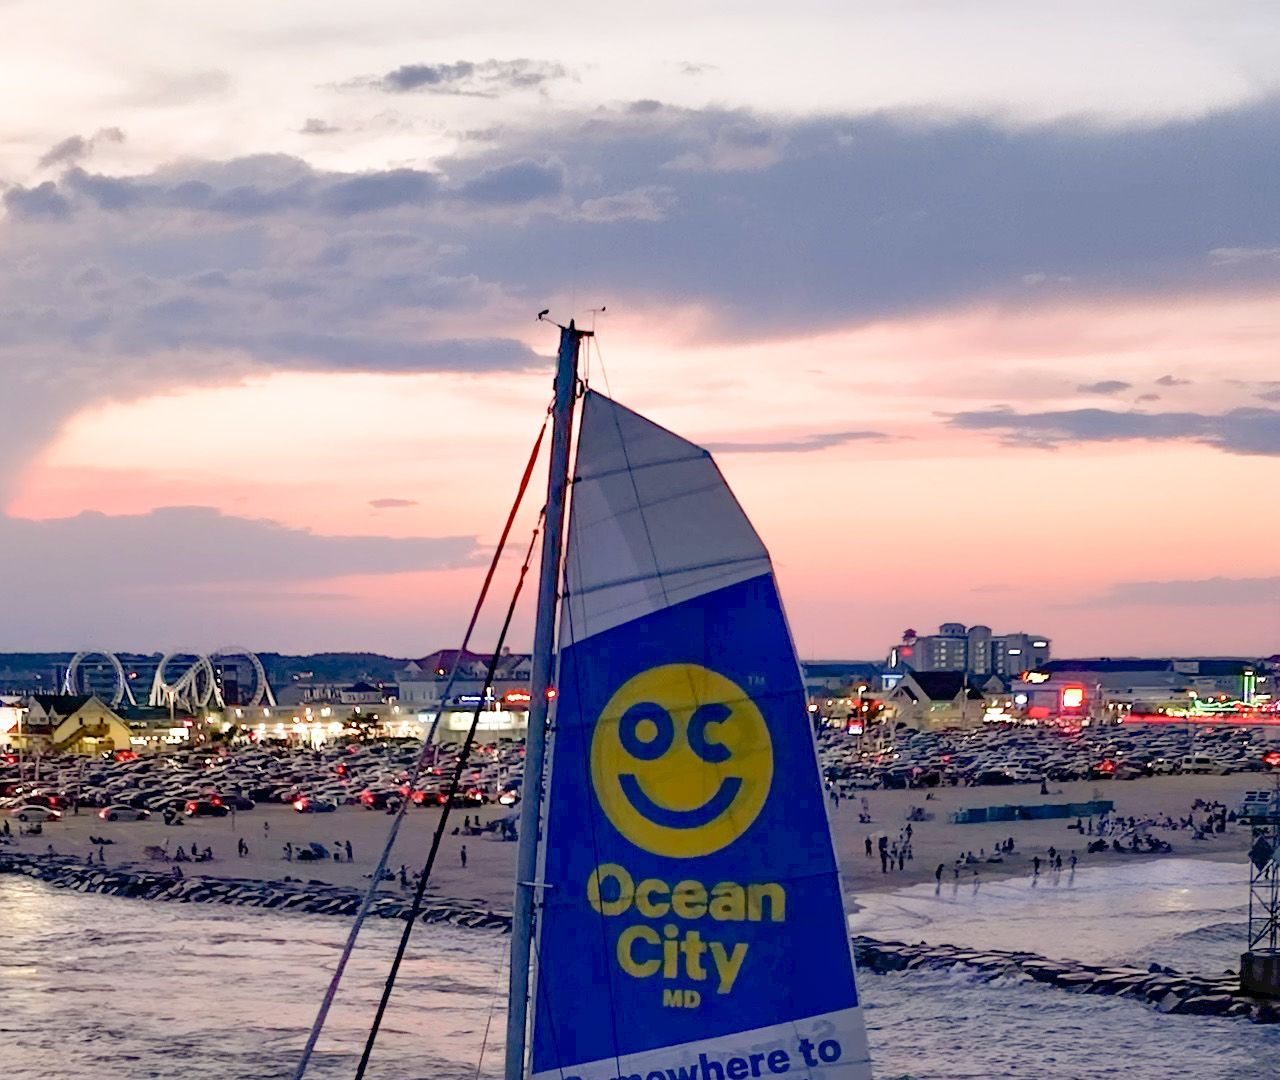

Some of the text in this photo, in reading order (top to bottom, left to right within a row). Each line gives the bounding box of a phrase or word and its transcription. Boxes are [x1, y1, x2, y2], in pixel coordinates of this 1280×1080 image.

[586, 863, 786, 922] Ocean
[615, 924, 748, 994] City
[663, 990, 700, 1008] MD
[798, 1038, 842, 1065] to
